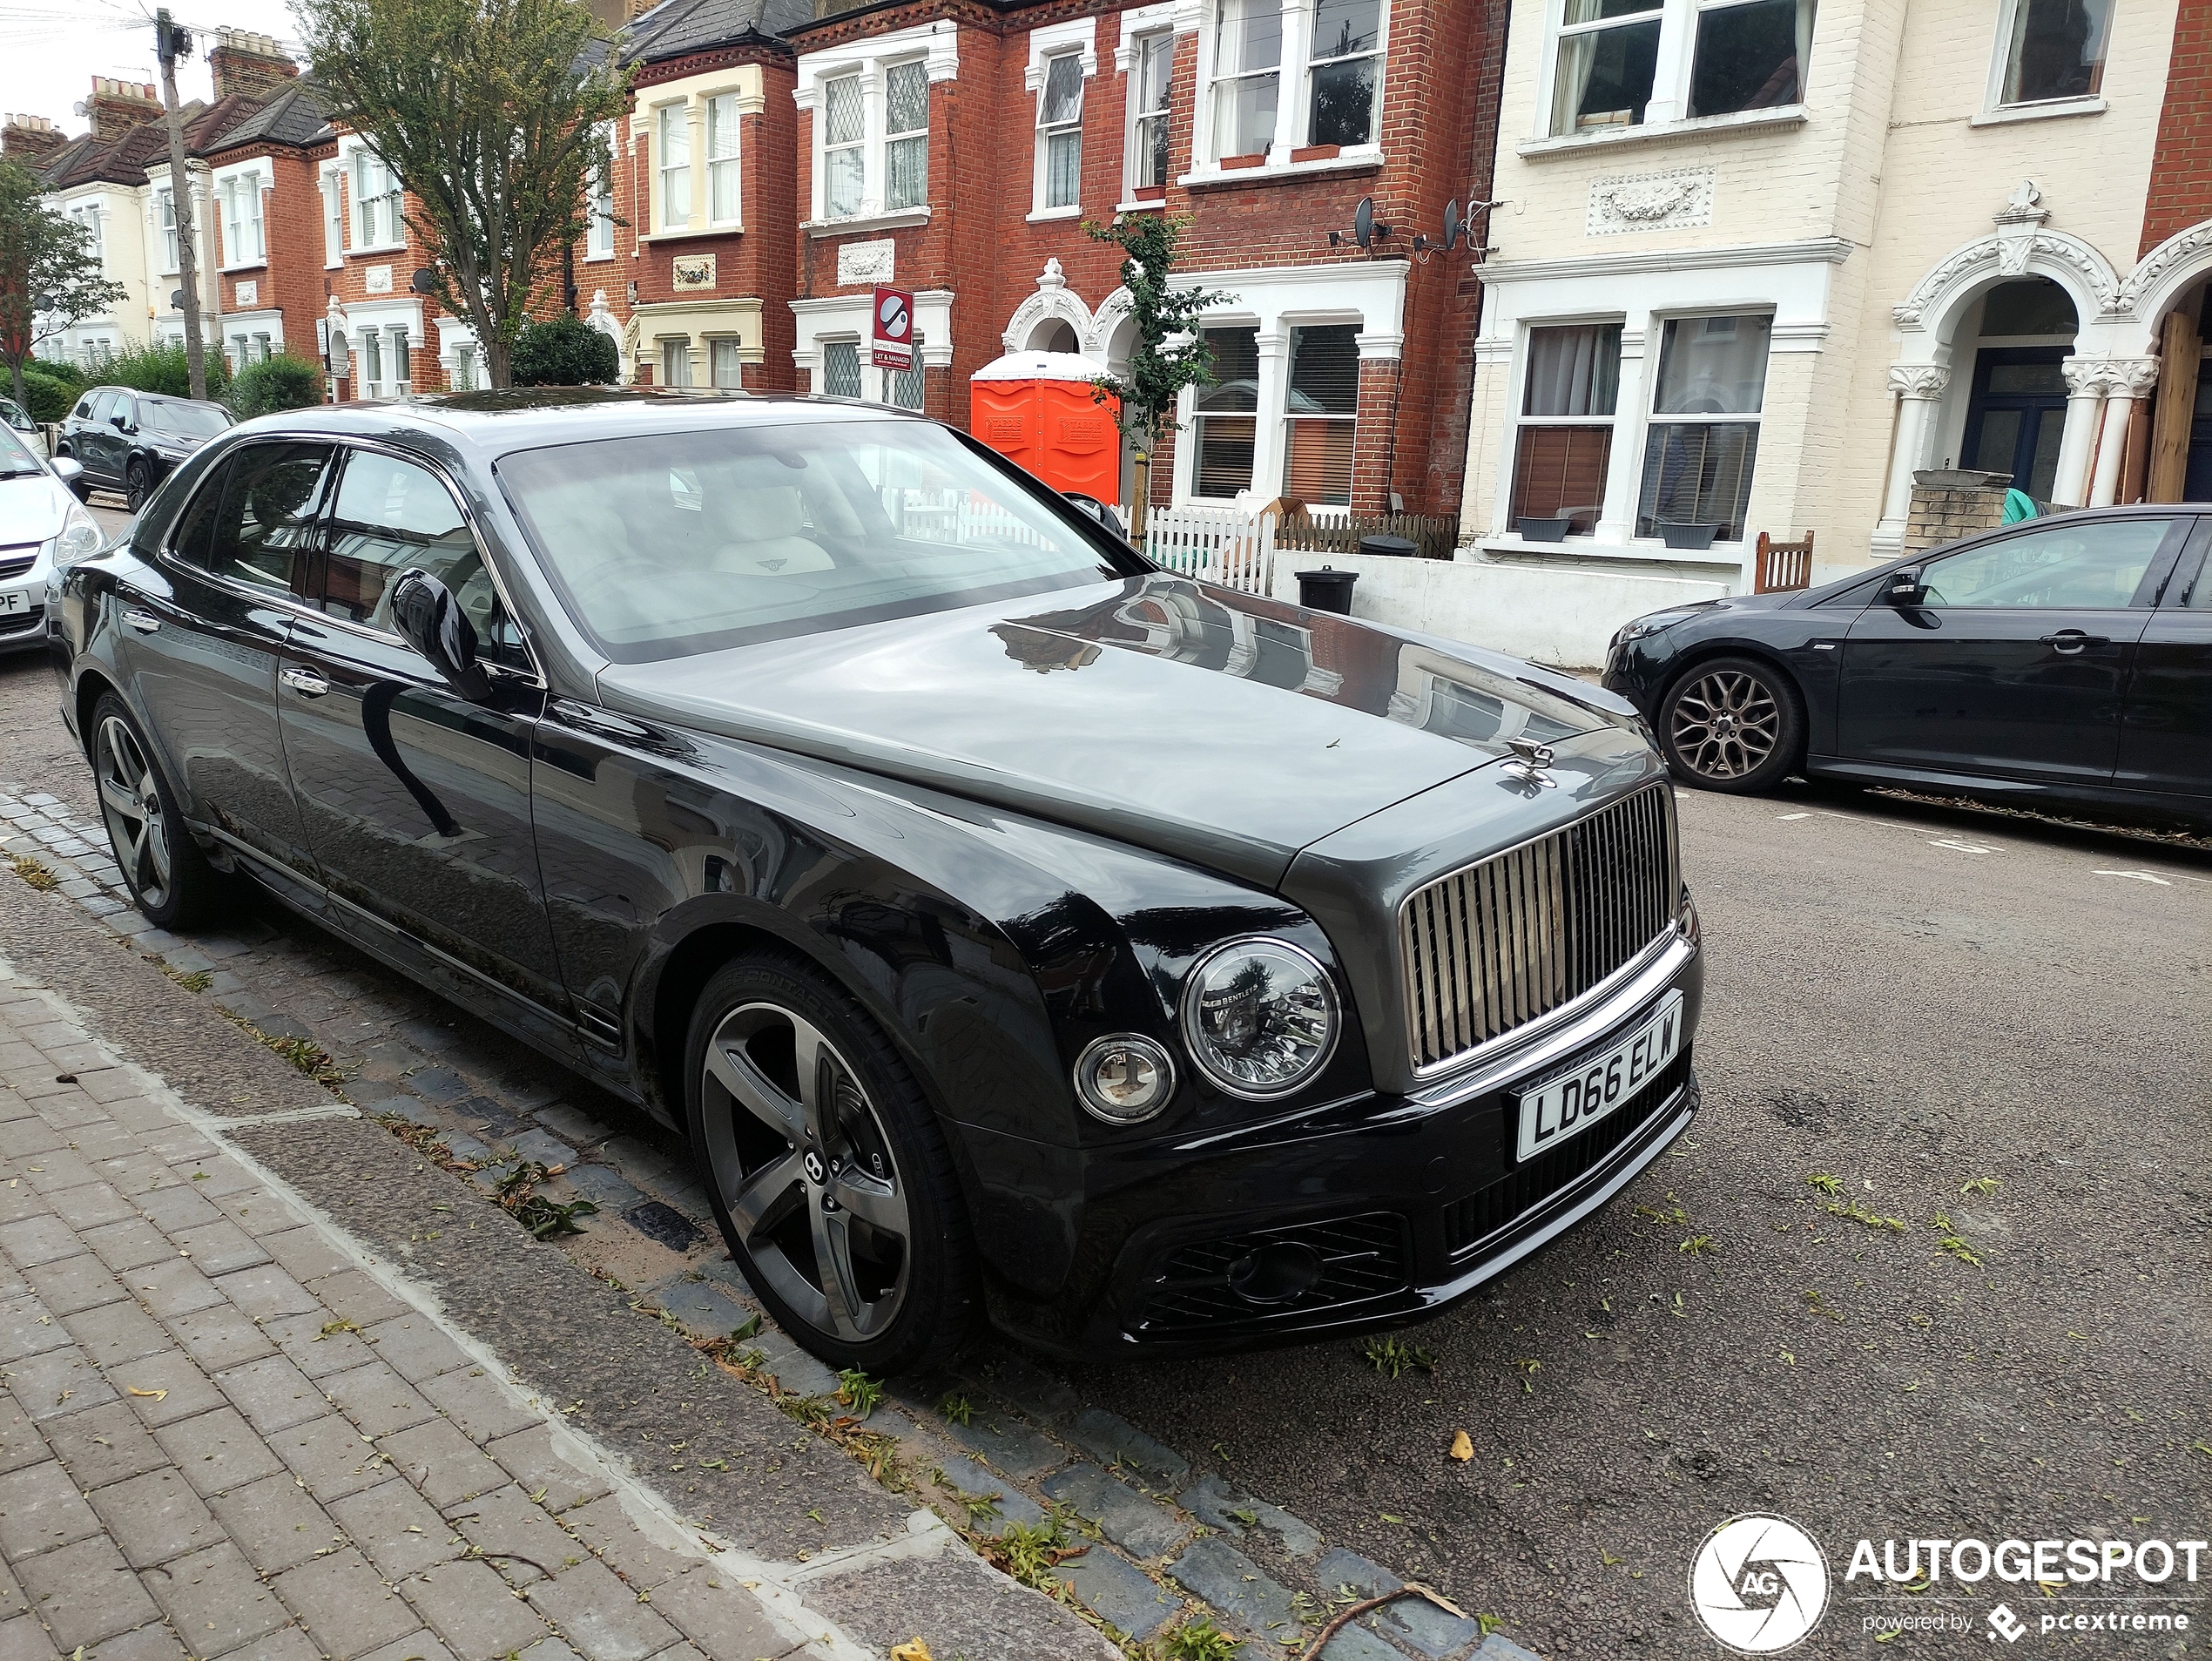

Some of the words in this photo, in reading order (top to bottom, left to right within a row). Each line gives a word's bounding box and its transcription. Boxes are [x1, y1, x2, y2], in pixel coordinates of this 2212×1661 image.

[874, 341, 889, 349] James
[888, 354, 910, 363] MANAGED
[993, 418, 1022, 428] TARDIS
[1070, 420, 1102, 429] TARDIS
[747, 970, 835, 1020] CONTACT
[1534, 1055, 1623, 1144] LD66
[1629, 1010, 1676, 1089] ELW
